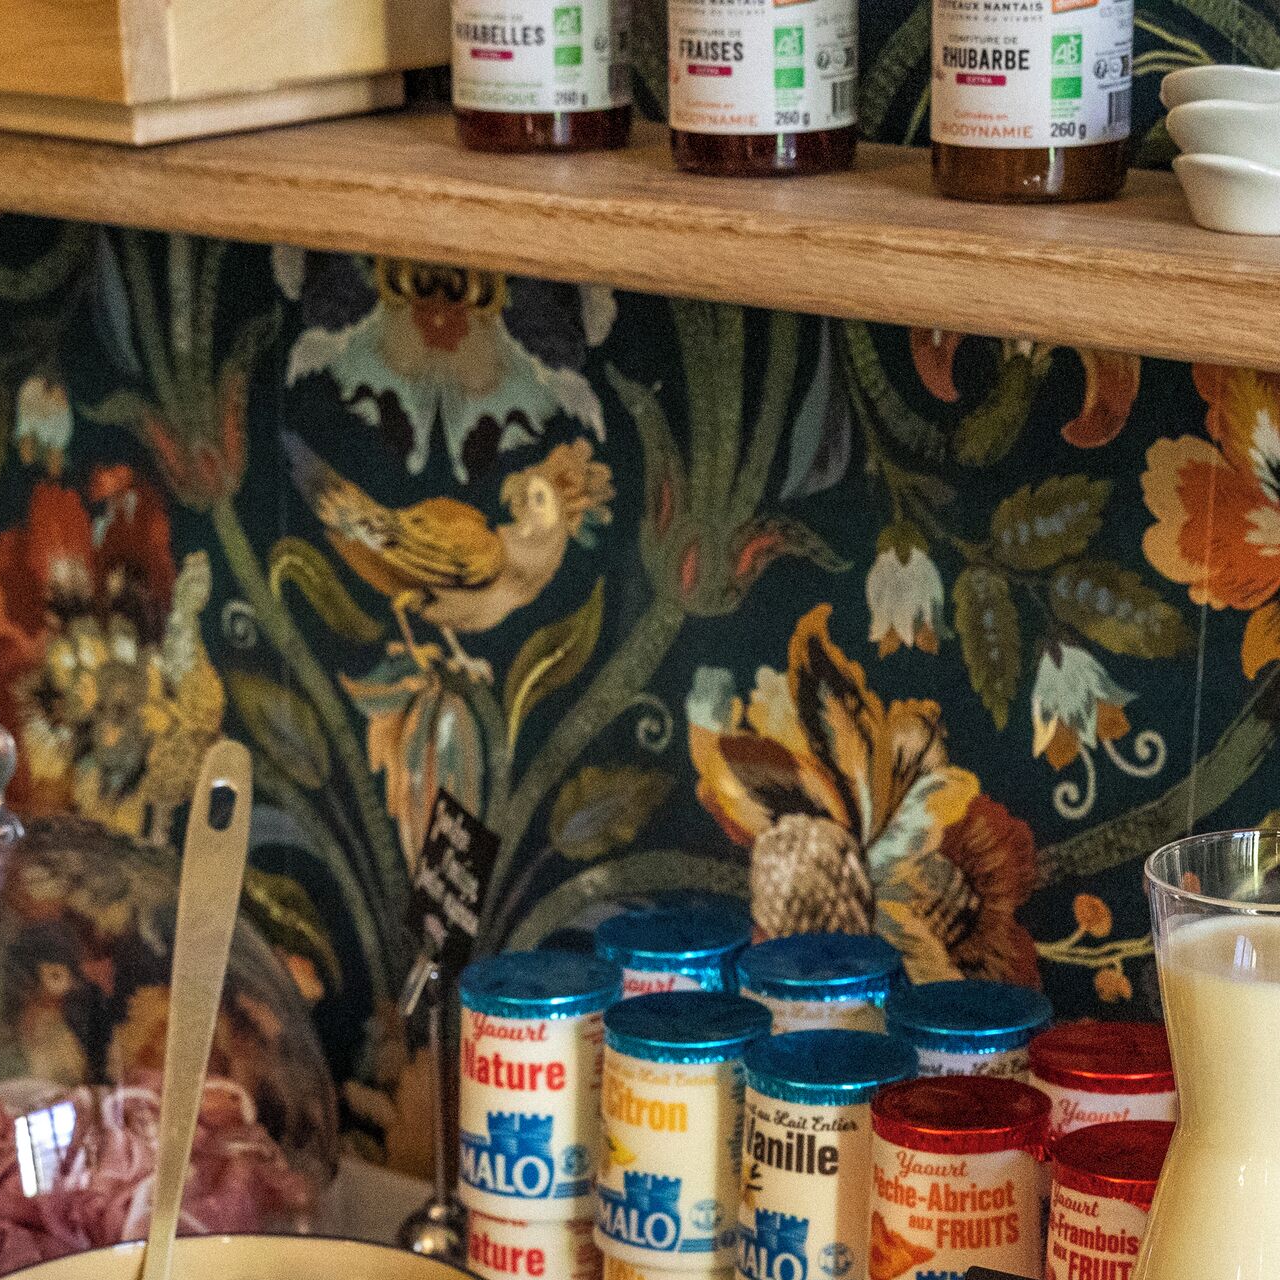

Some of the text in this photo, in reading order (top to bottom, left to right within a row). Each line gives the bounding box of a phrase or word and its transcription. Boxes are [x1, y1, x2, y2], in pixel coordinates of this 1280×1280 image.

[679, 39, 744, 63] FRAISES
[943, 46, 1030, 71] RHUBARBE
[775, 110, 801, 126] 260
[1050, 121, 1088, 140] 260 g
[471, 1010, 548, 1042] Yaourt
[462, 1037, 565, 1092] Nature
[773, 1109, 809, 1131] Lait
[811, 1114, 860, 1133] Entier
[896, 1150, 969, 1179] Yaourt
[936, 1212, 1020, 1250] FRUITS
[470, 1231, 546, 1278] ature
